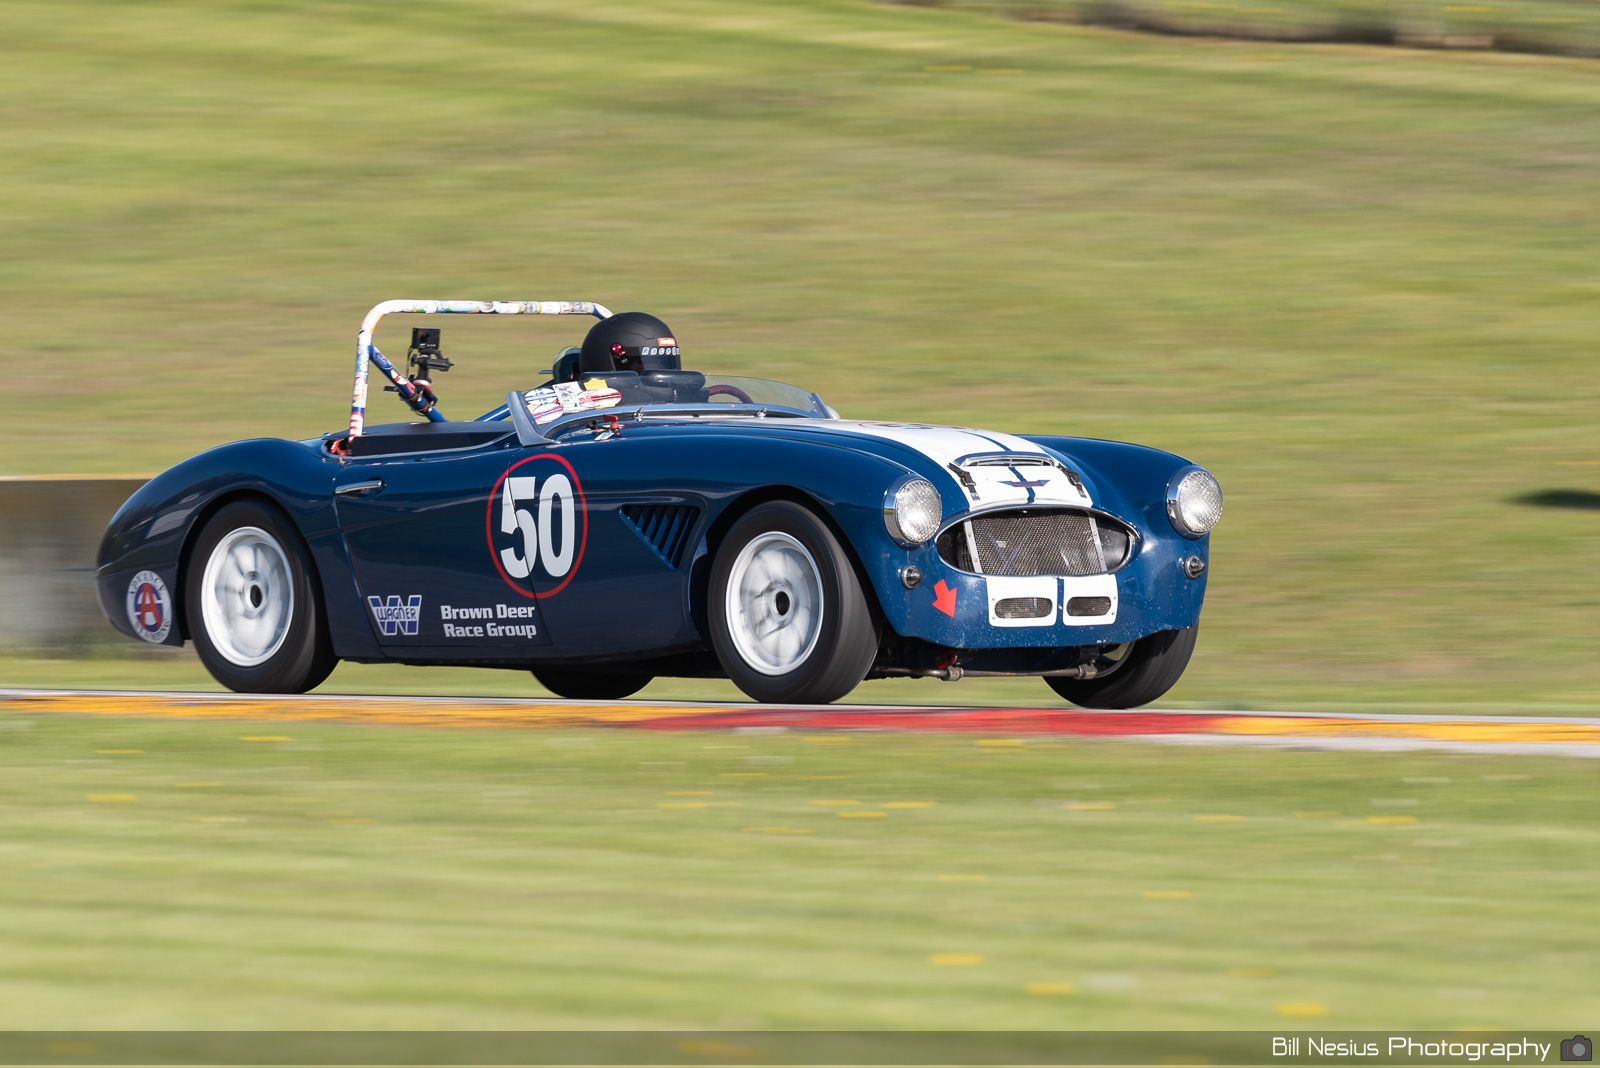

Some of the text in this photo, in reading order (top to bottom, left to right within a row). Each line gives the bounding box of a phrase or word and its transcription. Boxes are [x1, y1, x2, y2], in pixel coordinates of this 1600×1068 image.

[500, 473, 576, 579] 50
[376, 607, 417, 620] WAGNER
[440, 604, 535, 620] Brown Deer
[443, 623, 537, 639] Race Group
